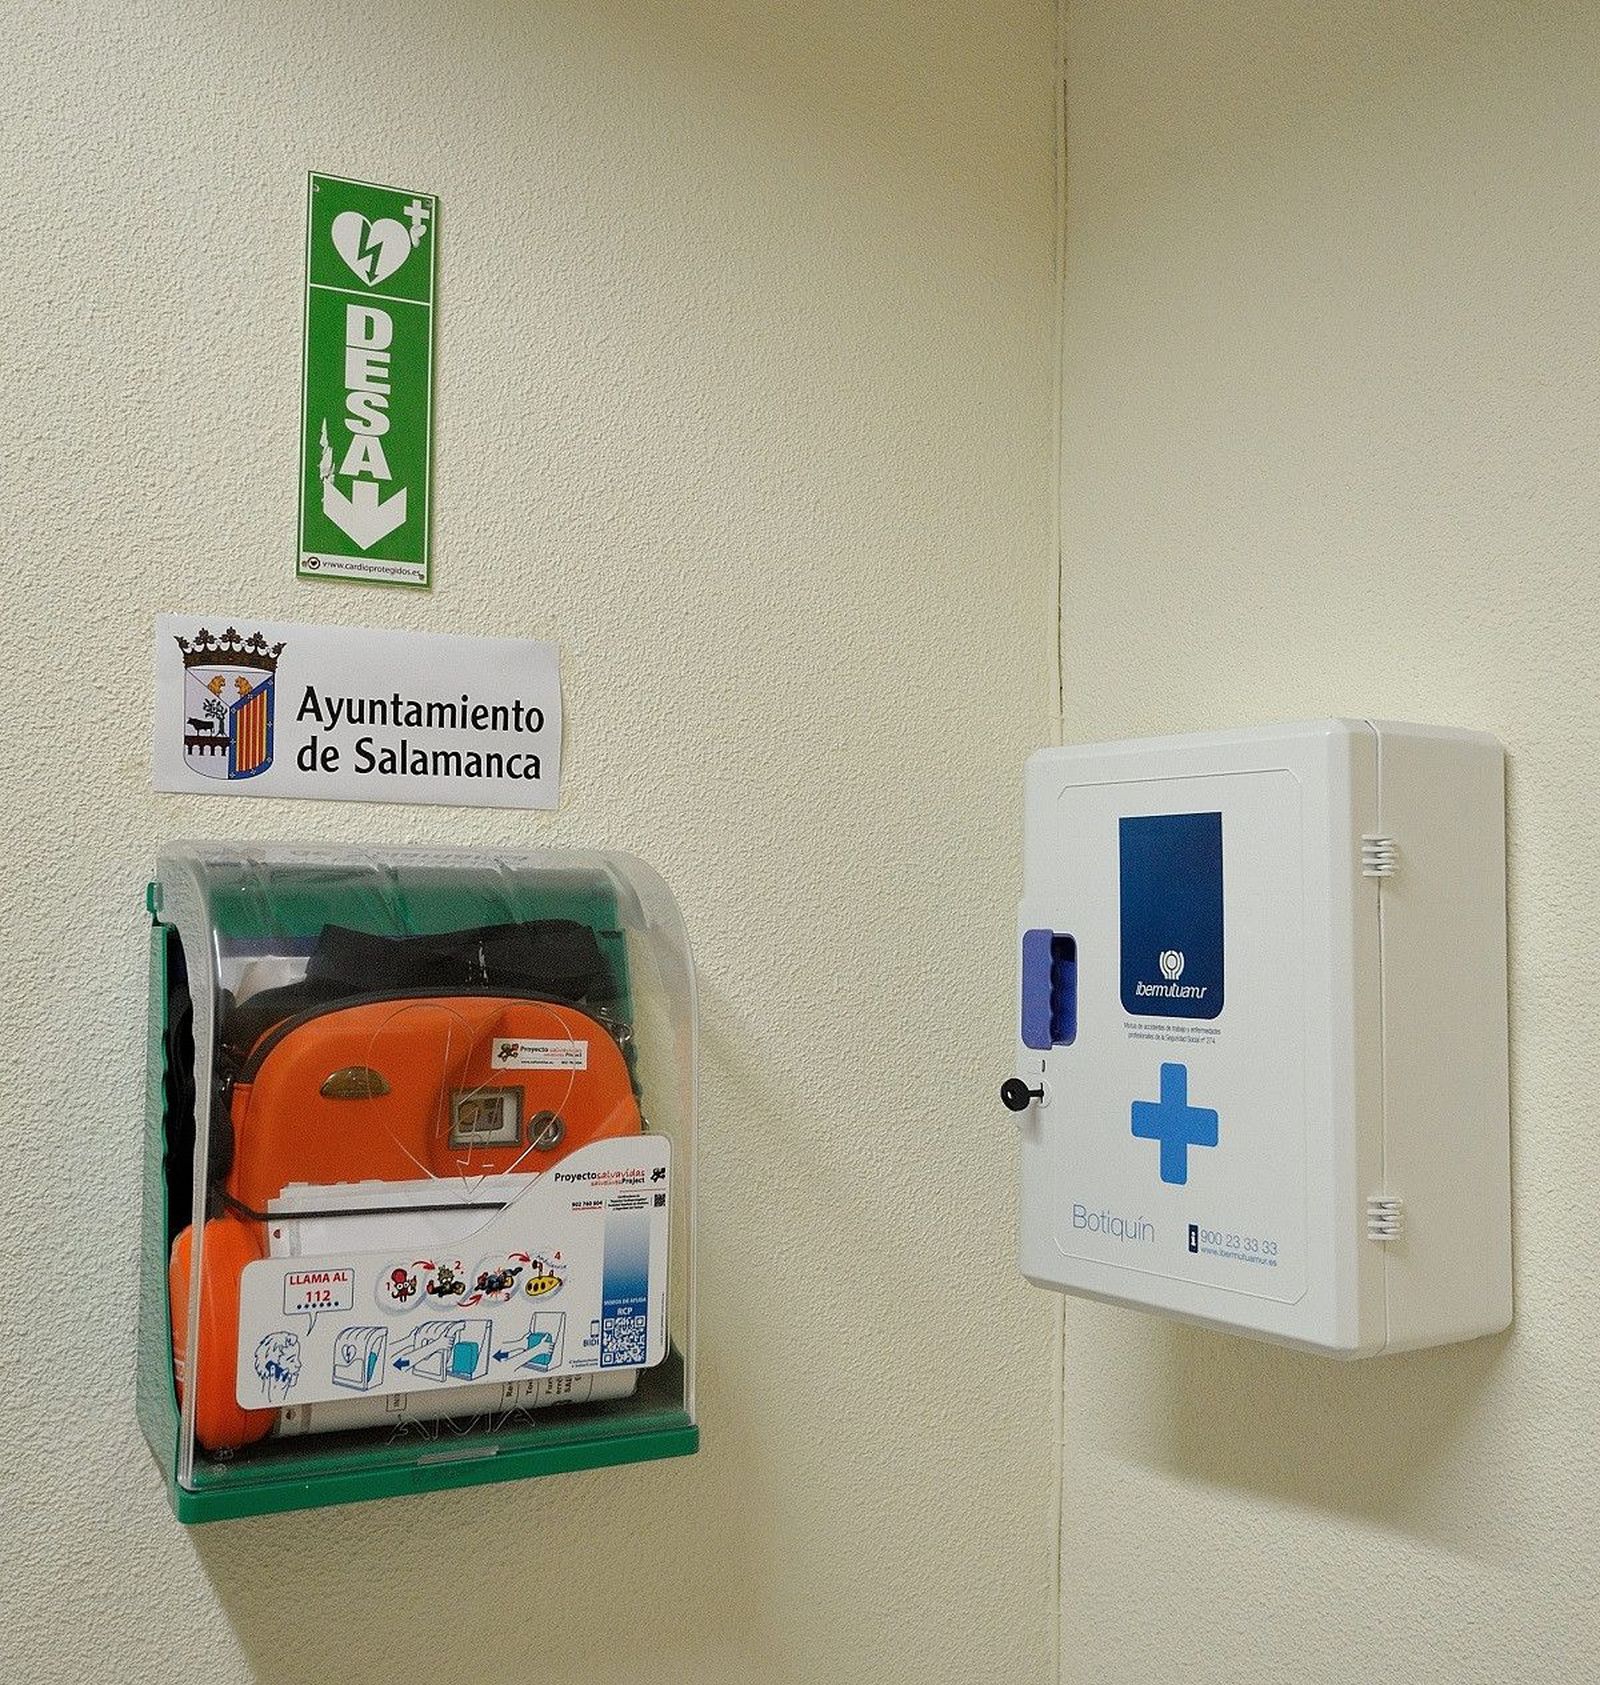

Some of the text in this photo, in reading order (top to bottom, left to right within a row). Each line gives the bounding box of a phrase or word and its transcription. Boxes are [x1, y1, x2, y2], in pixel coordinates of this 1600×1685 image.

[339, 304, 393, 480] DESA
[322, 560, 420, 576] www.cardioprotegidos.es
[296, 685, 544, 734] Ayuntamiento
[296, 735, 541, 780] de Salamanca
[1135, 981, 1207, 999] ibermutuamur
[1072, 1203, 1155, 1243] Botiquín
[1200, 1229, 1222, 1246] 900
[1225, 1234, 1241, 1249] 23
[1243, 1237, 1259, 1253] 33
[1261, 1240, 1278, 1256] 33
[554, 1251, 561, 1260] 4
[290, 1272, 348, 1285] LLAMA AL
[306, 1289, 331, 1303] 112
[504, 1292, 511, 1302] 3
[617, 1307, 633, 1315] RCP
